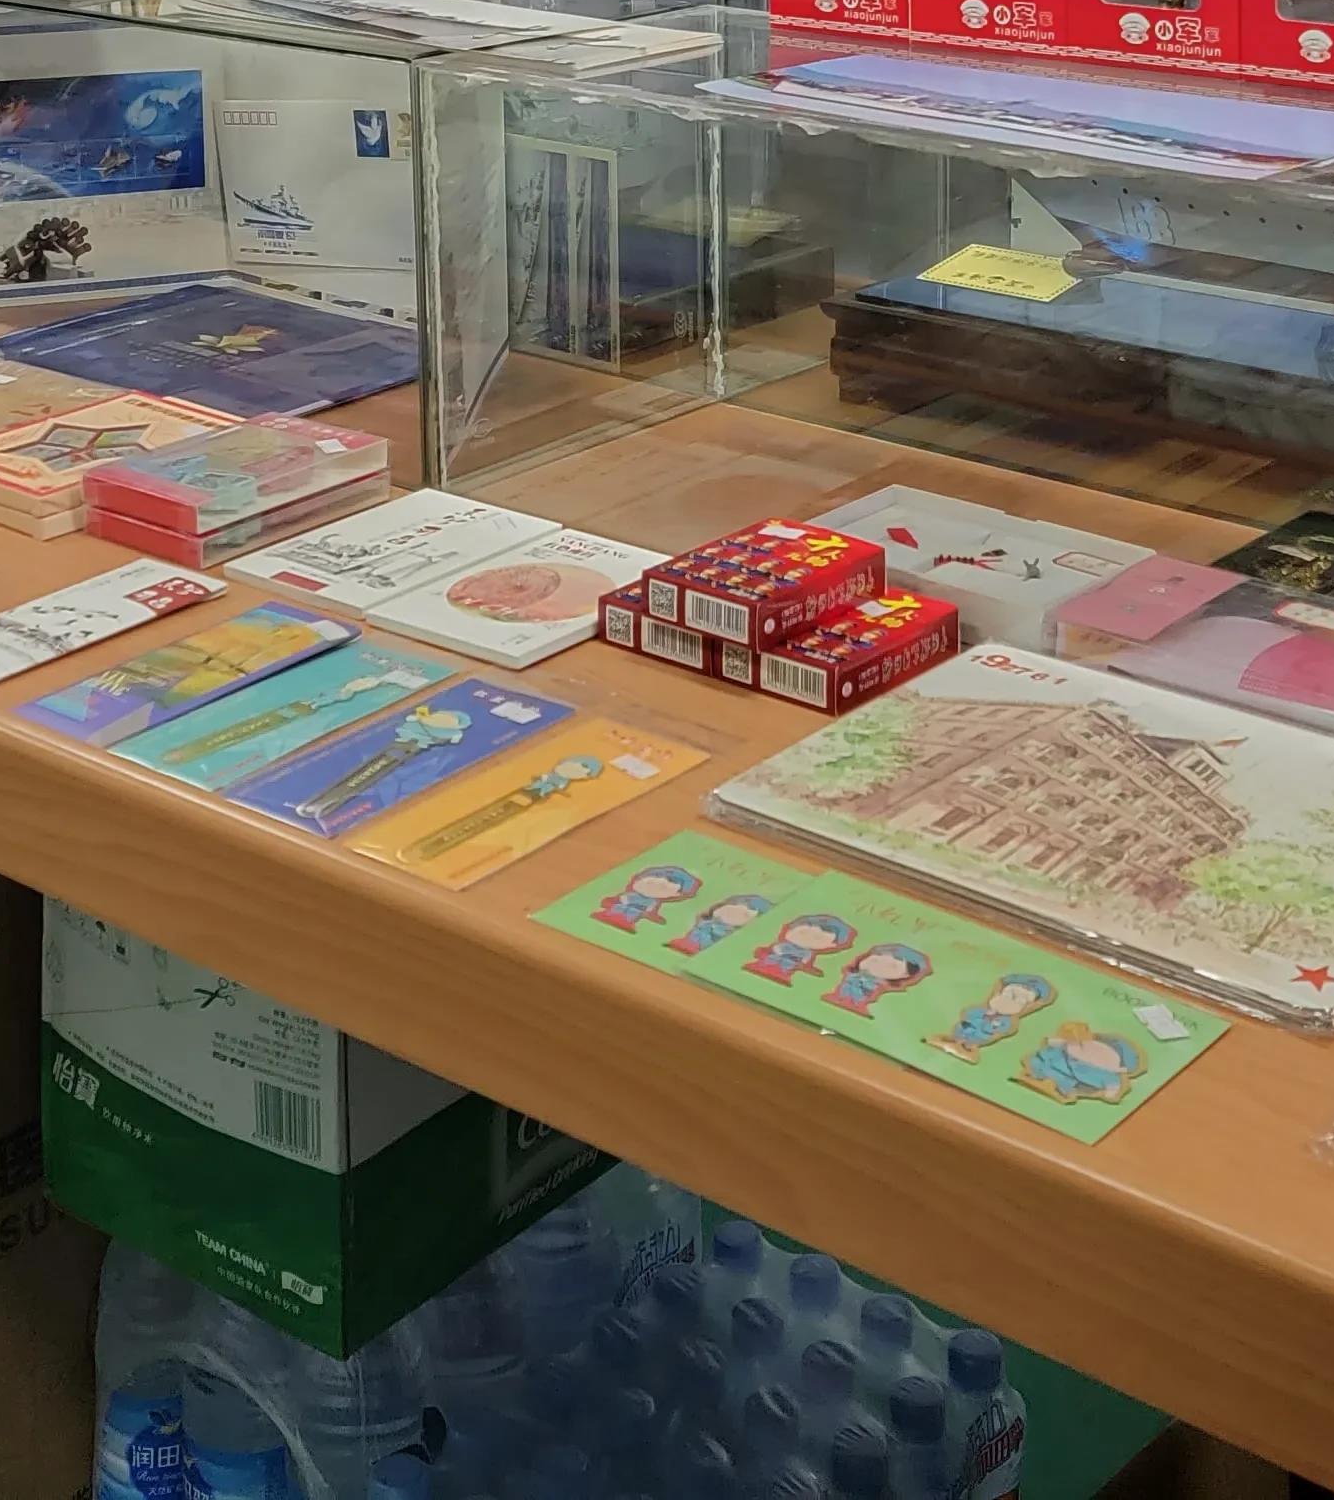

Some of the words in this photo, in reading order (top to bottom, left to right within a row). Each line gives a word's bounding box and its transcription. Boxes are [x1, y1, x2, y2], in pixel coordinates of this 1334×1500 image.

[843, 9, 899, 24] xiaojunjun
[994, 25, 1055, 41] xiaojunjun
[1155, 42, 1222, 57] xiaojunjun
[194, 1228, 227, 1259] TEAM
[228, 1247, 267, 1277] CHINA
[131, 1443, 181, 1470] 润田
